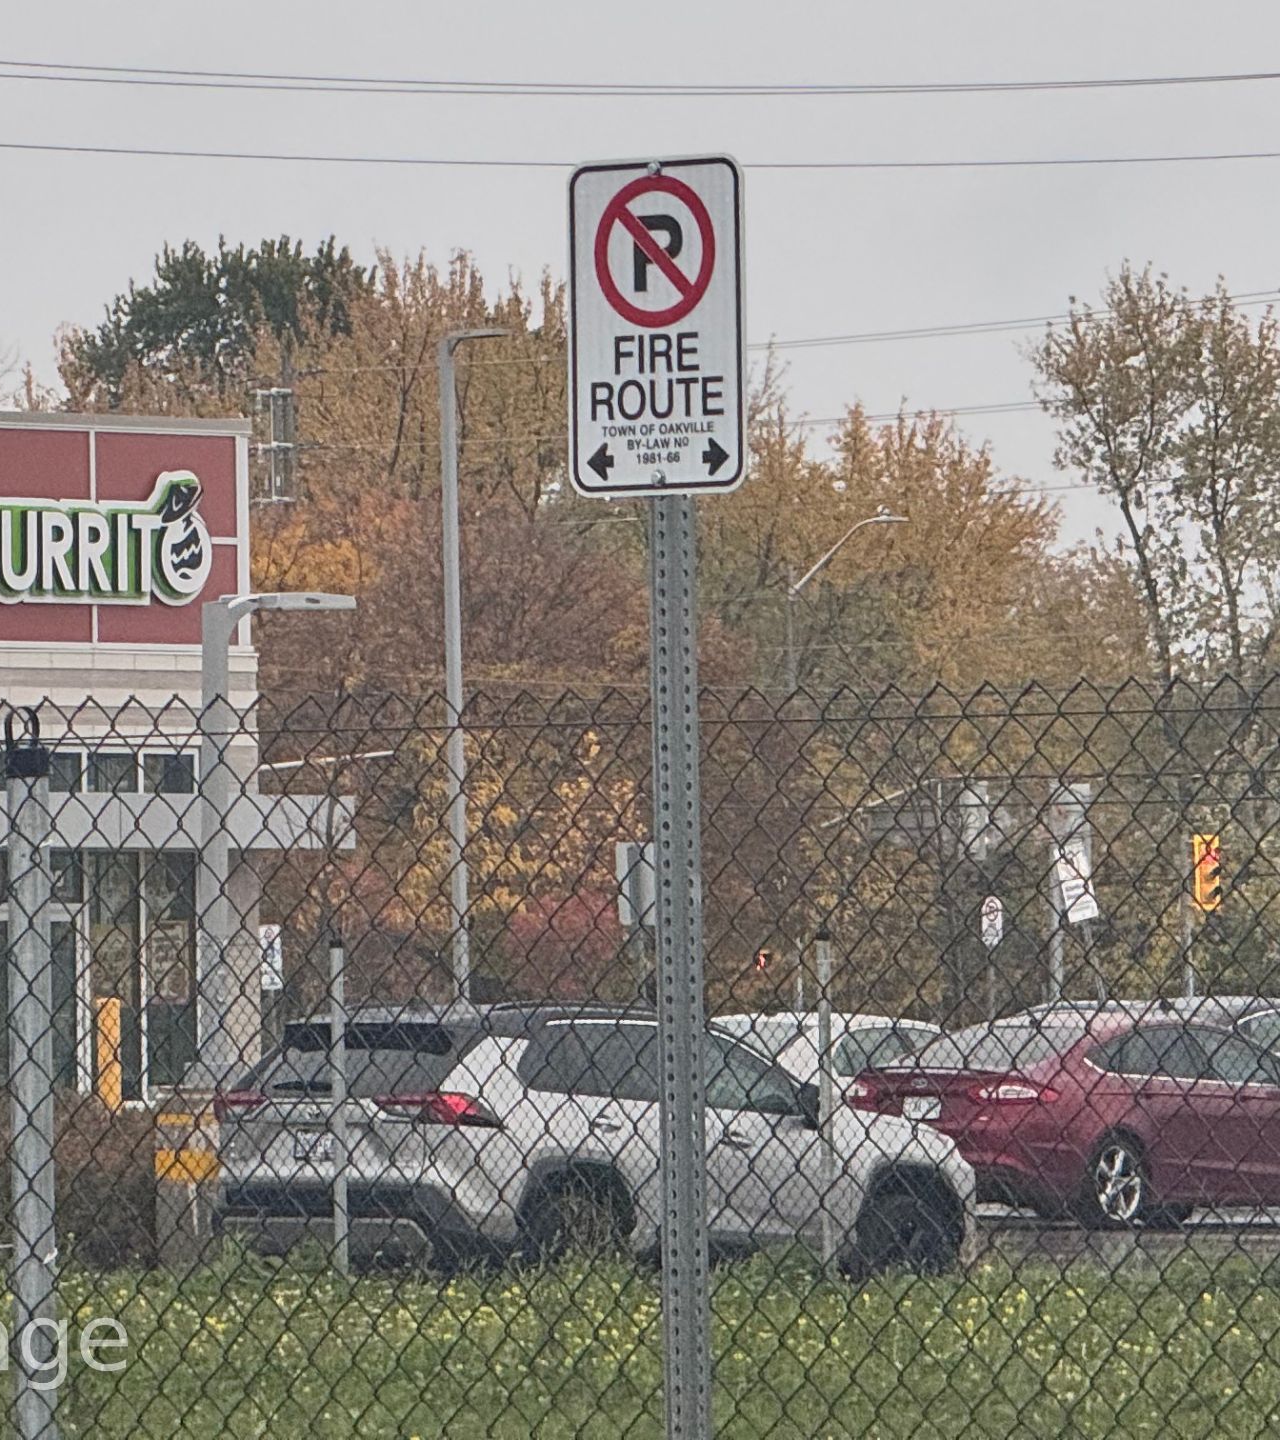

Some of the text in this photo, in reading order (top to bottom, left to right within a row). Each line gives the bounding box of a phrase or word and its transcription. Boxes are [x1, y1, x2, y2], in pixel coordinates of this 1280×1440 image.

[614, 331, 701, 375] FIRE
[591, 376, 725, 421] ROUTE
[602, 420, 715, 437] TOWN OF OAKVILLE
[627, 437, 670, 451] BY-LAW
